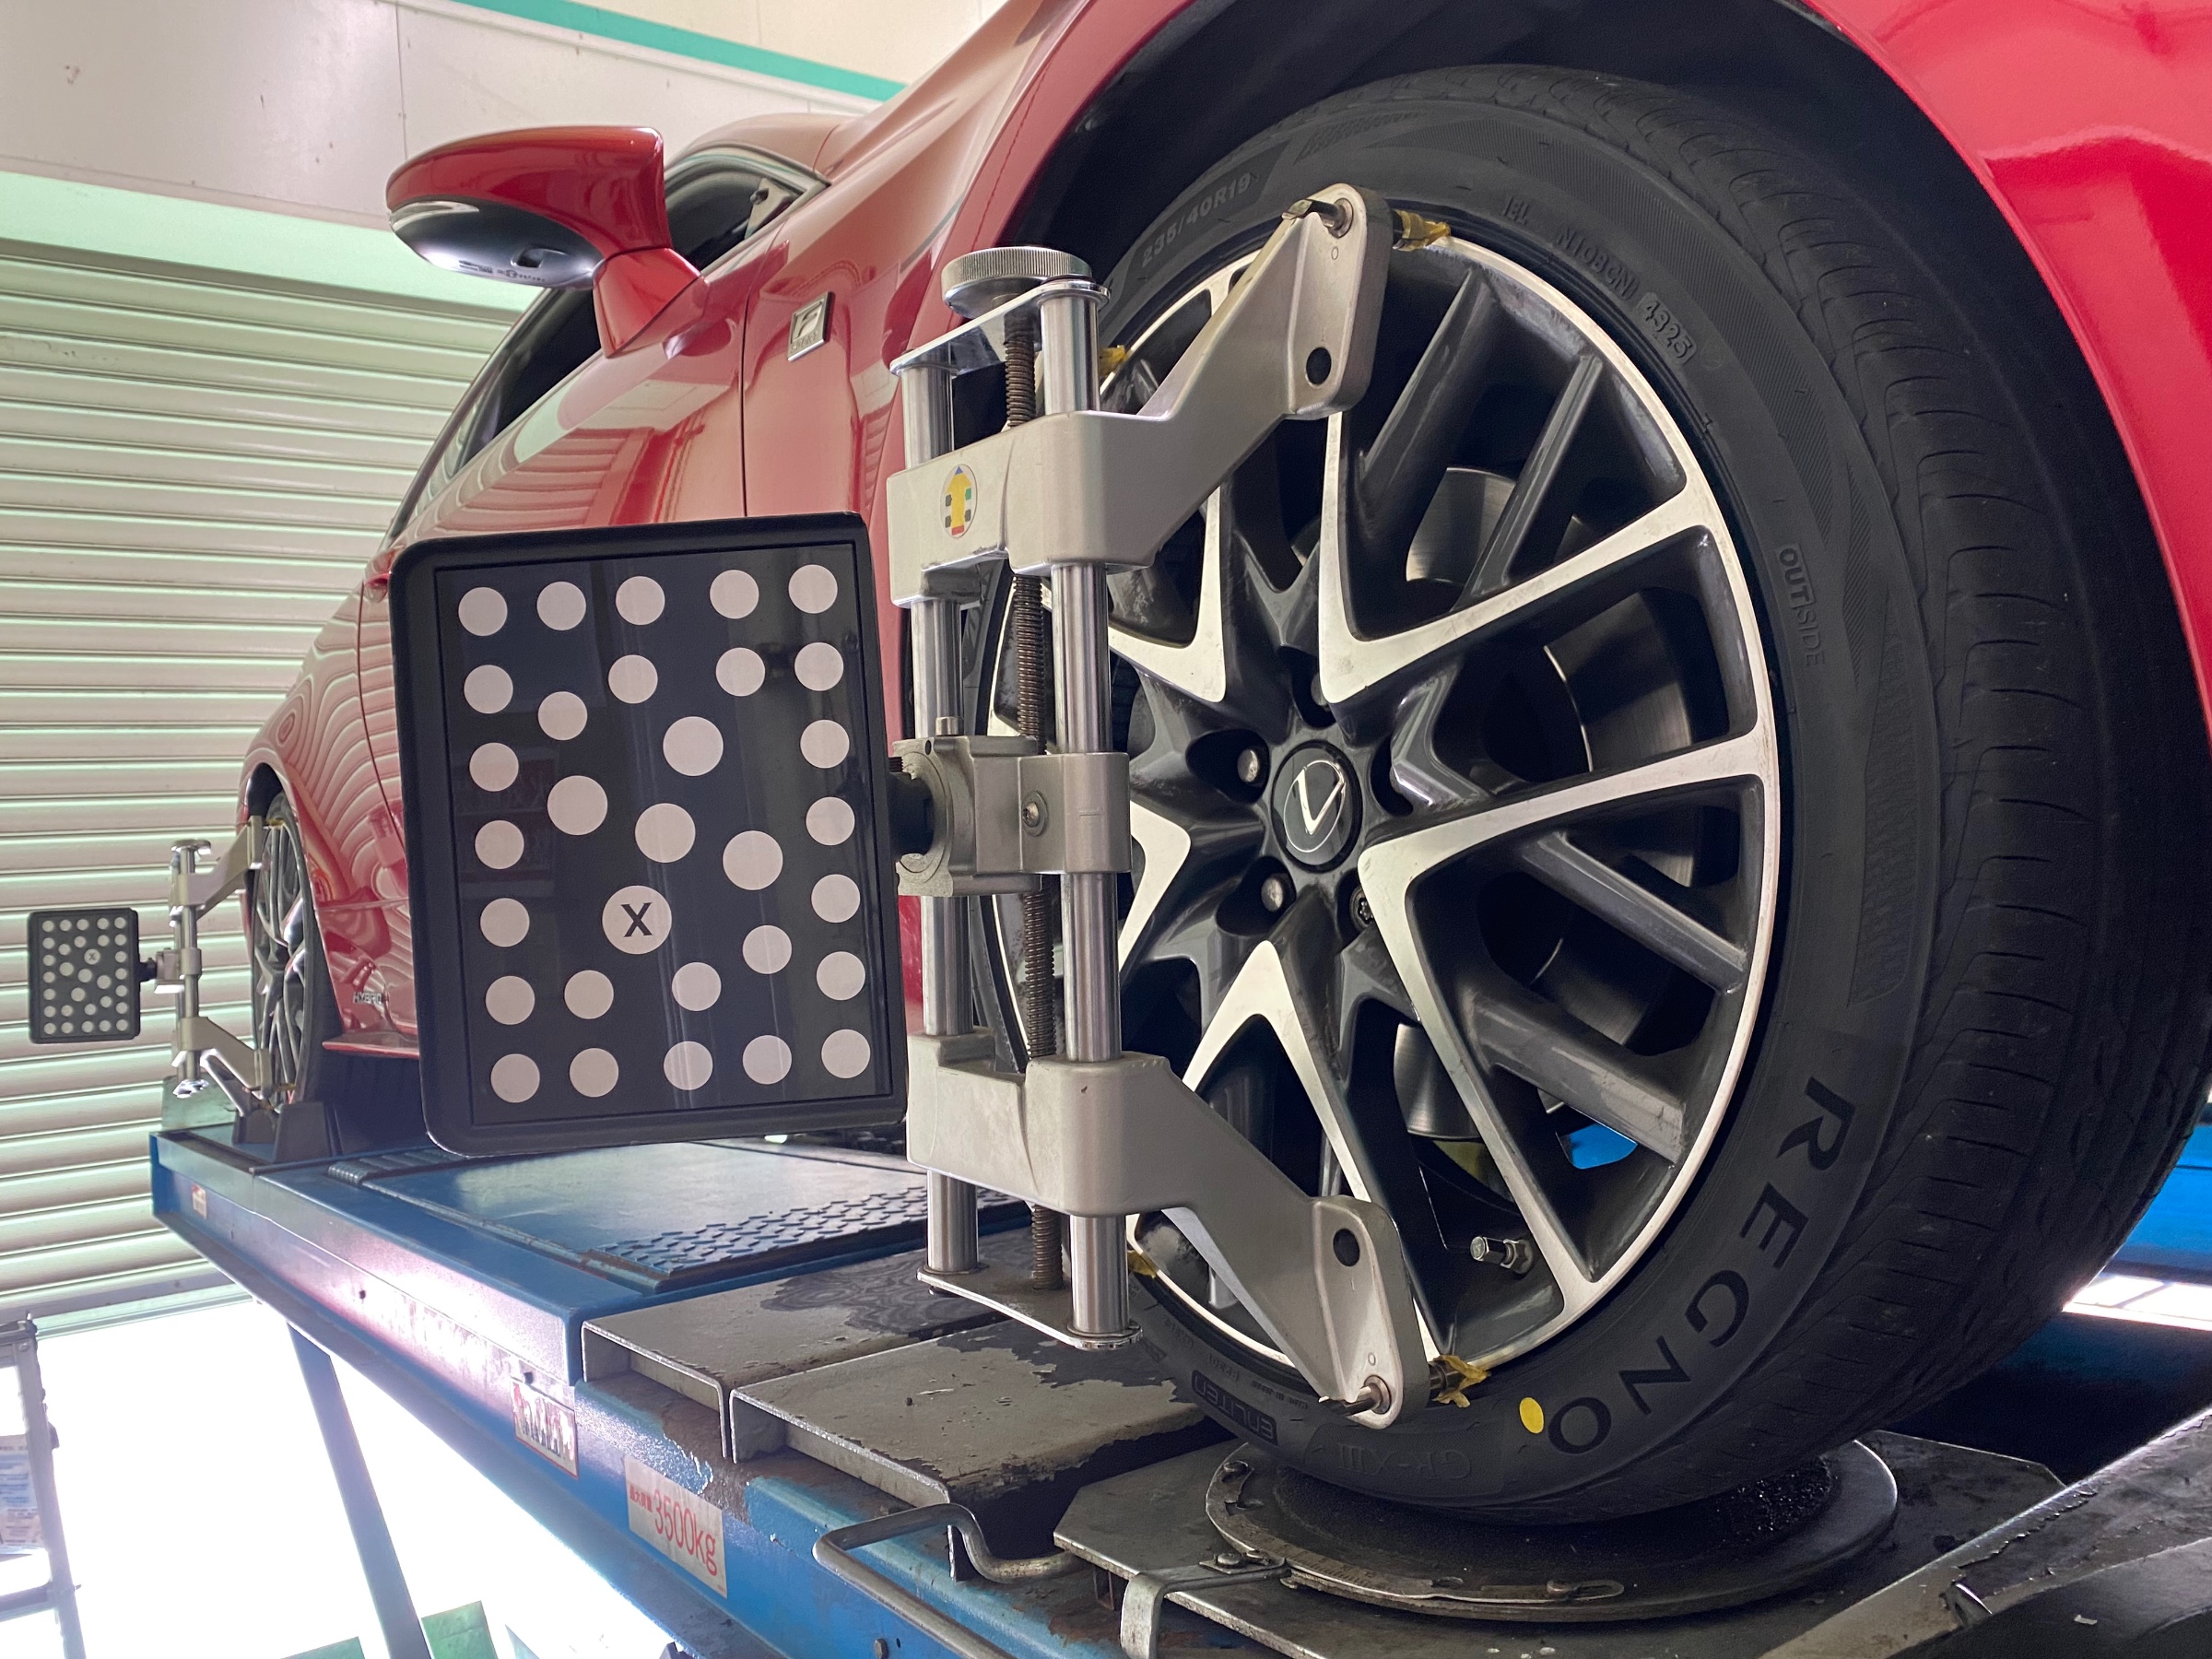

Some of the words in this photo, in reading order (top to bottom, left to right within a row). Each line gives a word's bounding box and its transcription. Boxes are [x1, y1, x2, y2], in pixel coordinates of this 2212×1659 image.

[1779, 547, 1825, 666] OUTSIDE
[621, 901, 653, 937] X
[1547, 1076, 1856, 1454] REGNO
[653, 1489, 717, 1577] 3500kg
